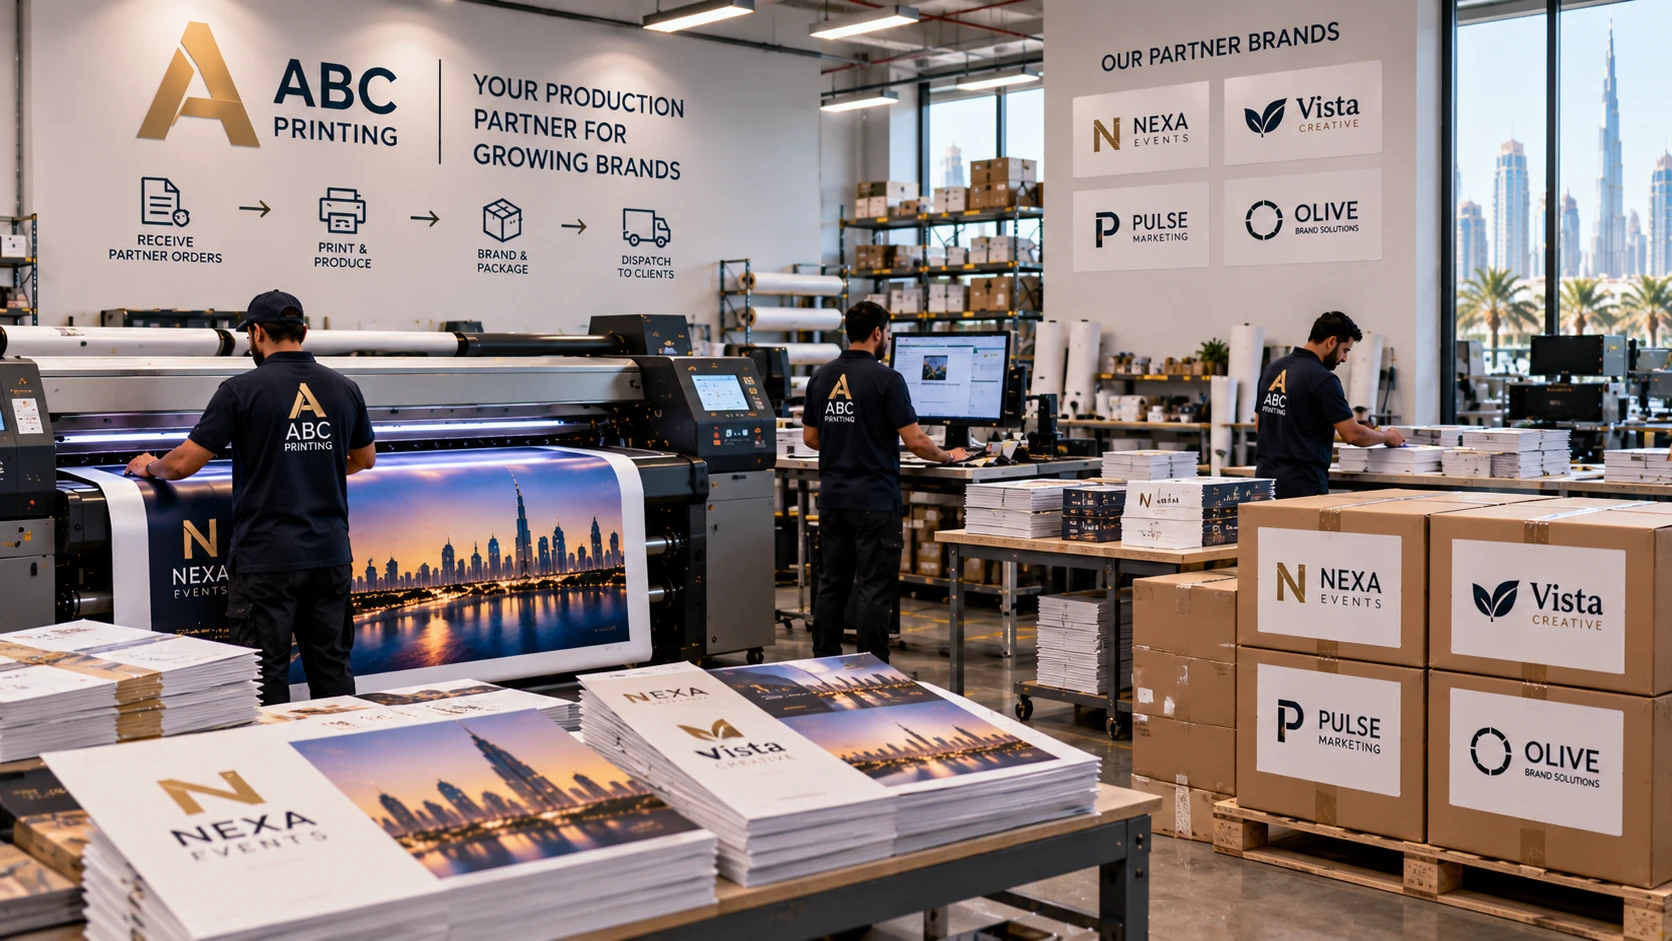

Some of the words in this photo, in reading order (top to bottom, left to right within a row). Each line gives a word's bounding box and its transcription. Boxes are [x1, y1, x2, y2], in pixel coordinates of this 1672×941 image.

[1101, 50, 1142, 72] OUR
[1150, 36, 1241, 65] PARTNER
[1249, 22, 1340, 51] BRANDS
[273, 58, 398, 115] ABC
[473, 73, 538, 102] YOUR
[546, 83, 684, 118] PRODUCTION
[1296, 95, 1360, 120] Vista
[273, 117, 398, 147] PRINTING
[474, 108, 577, 139] PARTNER
[585, 120, 627, 144] FOR
[1134, 112, 1188, 134] NEXA
[1299, 119, 1360, 133] CREATIVE
[1093, 117, 1120, 153] N
[1134, 134, 1189, 147] EVENTS
[473, 143, 589, 174] GROWING
[596, 156, 681, 181] BRANDS
[1133, 212, 1188, 231] PULSE
[1295, 201, 1358, 223] OLIVE
[1133, 232, 1188, 243] MARKETING
[1295, 226, 1318, 235] BRAND
[1320, 224, 1359, 234] SOLUTIONS
[137, 234, 194, 248] RECEIVE
[318, 242, 355, 255] PRINT
[358, 243, 368, 255] &
[109, 249, 168, 263] PARTNER
[171, 251, 222, 264] ORDERS
[314, 256, 371, 269] PRODUCE
[477, 249, 516, 261] BRAND
[519, 250, 528, 261] &
[621, 255, 671, 267] DISPATCH
[477, 263, 528, 275] PACKAGE
[618, 268, 631, 278] TO
[635, 268, 674, 279] CLIENTS
[825, 401, 854, 415] ABC
[1264, 393, 1287, 408] ABC
[285, 421, 331, 440] ABC
[284, 441, 332, 451] PRINTING
[172, 564, 230, 585] NEXA
[1277, 562, 1306, 603] N
[1321, 567, 1382, 594] NEXA
[174, 586, 228, 599] EVENTS
[1321, 594, 1382, 609] EVENTS
[1530, 582, 1604, 616] Vista
[1532, 615, 1603, 631] CREATIVE
[622, 687, 709, 703] NEXA
[1319, 710, 1381, 739] PULSE
[694, 741, 786, 762] Vista
[1318, 736, 1381, 754] MARKETING
[715, 754, 796, 770] CREATIVE
[1524, 741, 1600, 774] OLIVE
[1524, 768, 1552, 781] BRAND
[1554, 772, 1600, 788] SOLUTIONS
[170, 811, 318, 847] NEXA
[191, 830, 327, 862] EVENTS
